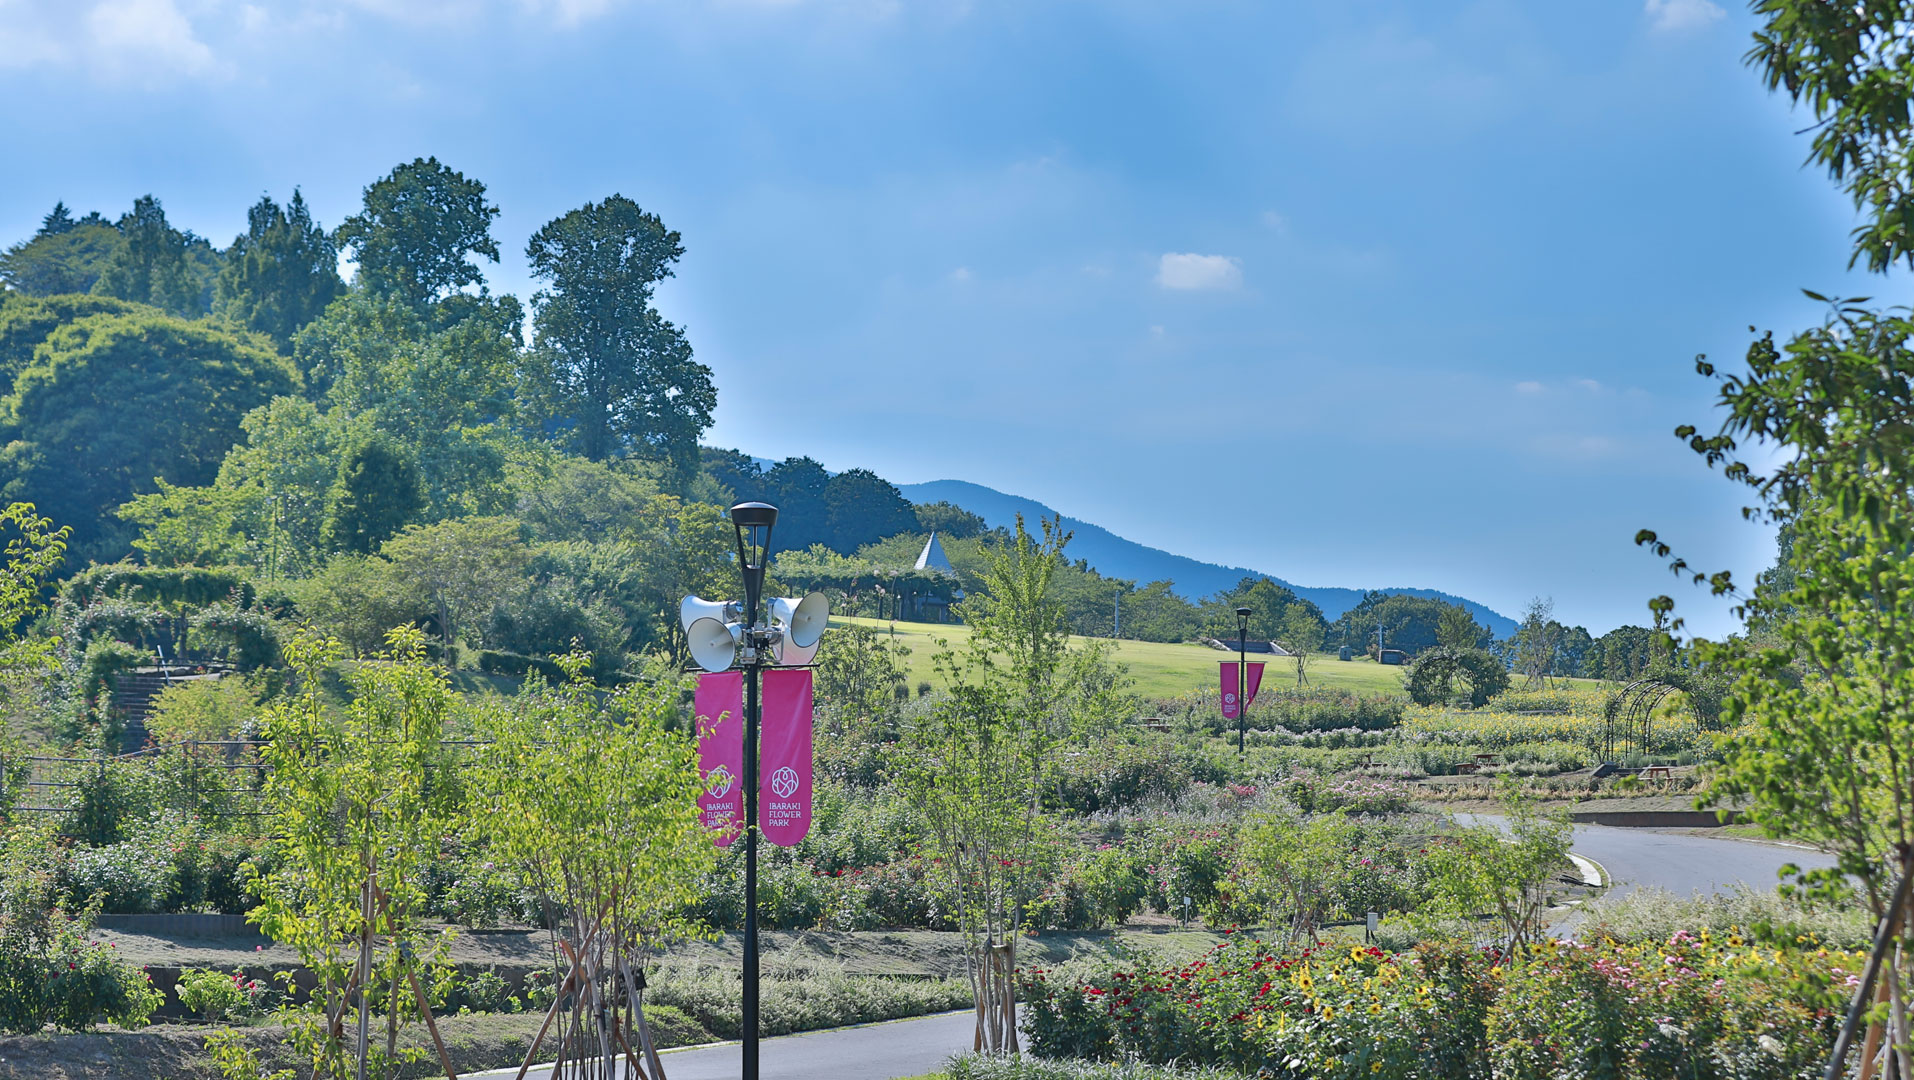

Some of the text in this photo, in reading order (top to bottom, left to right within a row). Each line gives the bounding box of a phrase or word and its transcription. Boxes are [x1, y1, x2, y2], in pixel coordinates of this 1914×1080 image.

[706, 802, 733, 811] IBARAKI
[769, 802, 801, 810] IBARAKI
[707, 811, 735, 819] FLOWE
[769, 811, 802, 819] FLOWER
[769, 819, 790, 827] PARK
